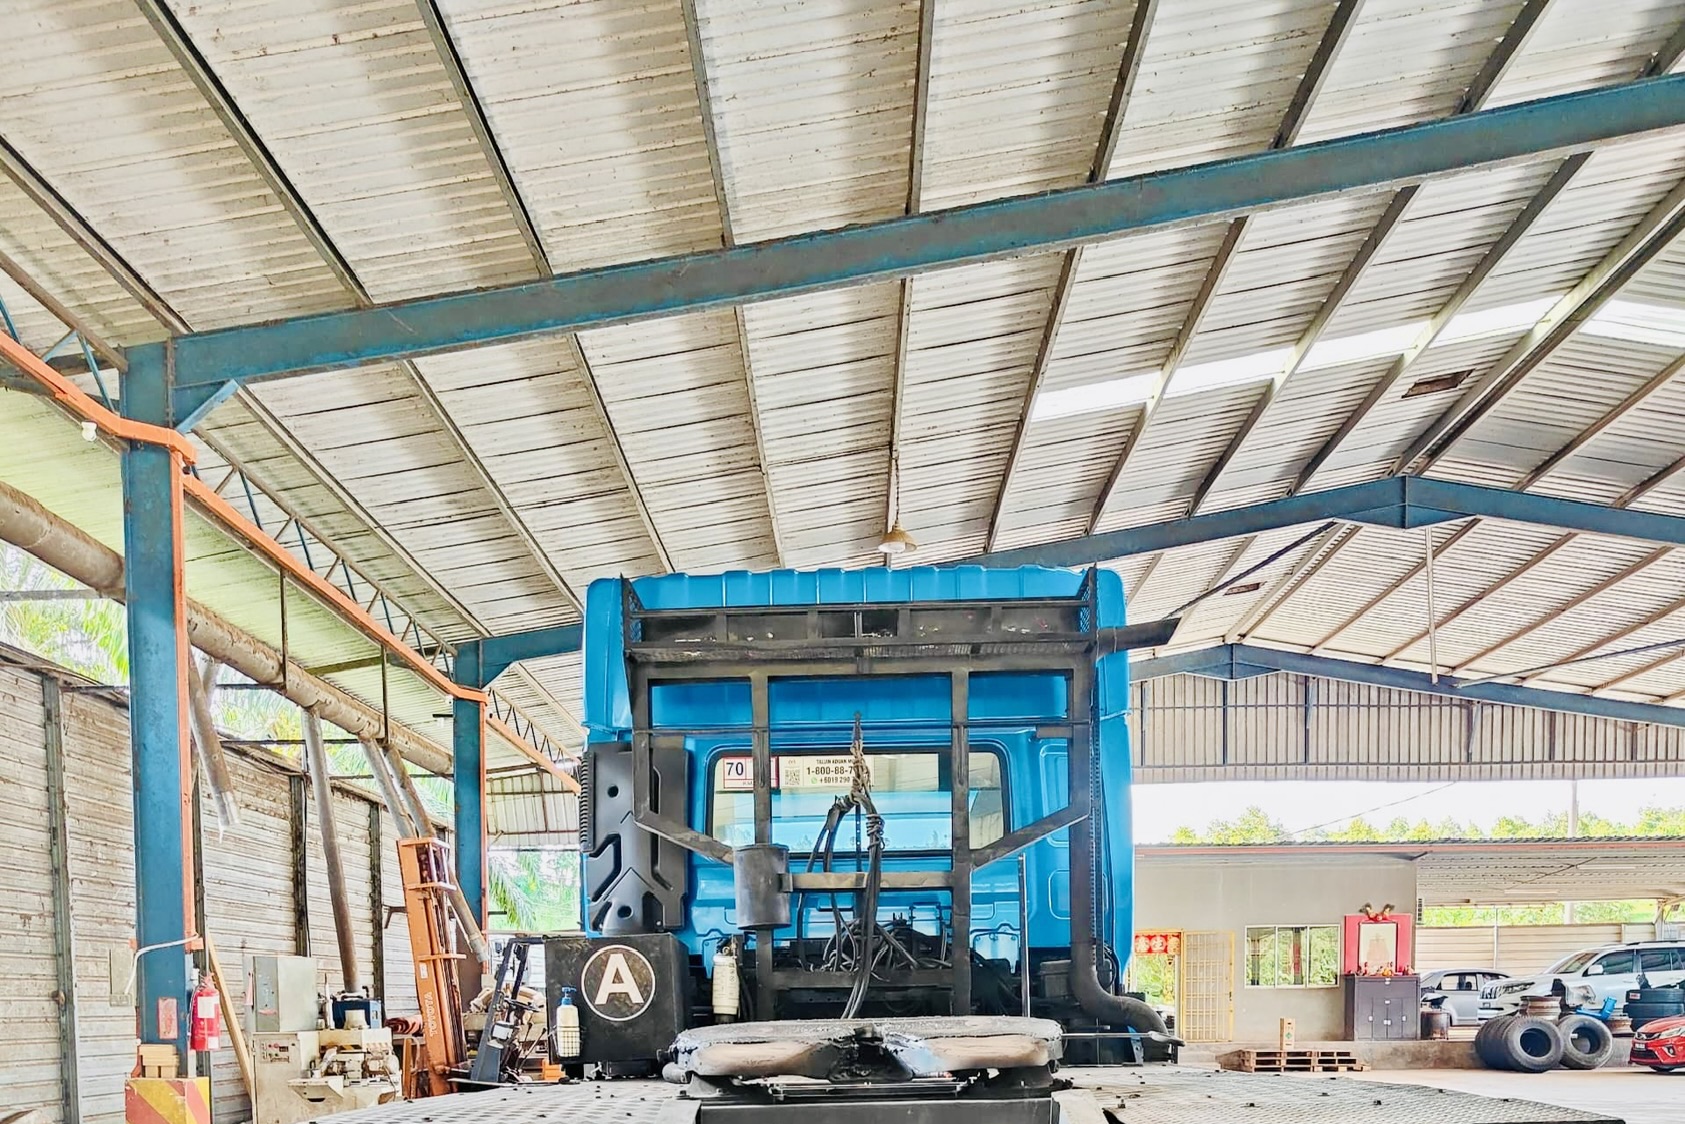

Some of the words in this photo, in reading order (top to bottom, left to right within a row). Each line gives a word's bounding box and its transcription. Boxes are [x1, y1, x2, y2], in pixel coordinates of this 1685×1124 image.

[726, 762, 744, 776] 70
[806, 766, 854, 775] 1-800-88-7
[594, 953, 645, 1005] A
[424, 991, 438, 1037] TOYOTA
